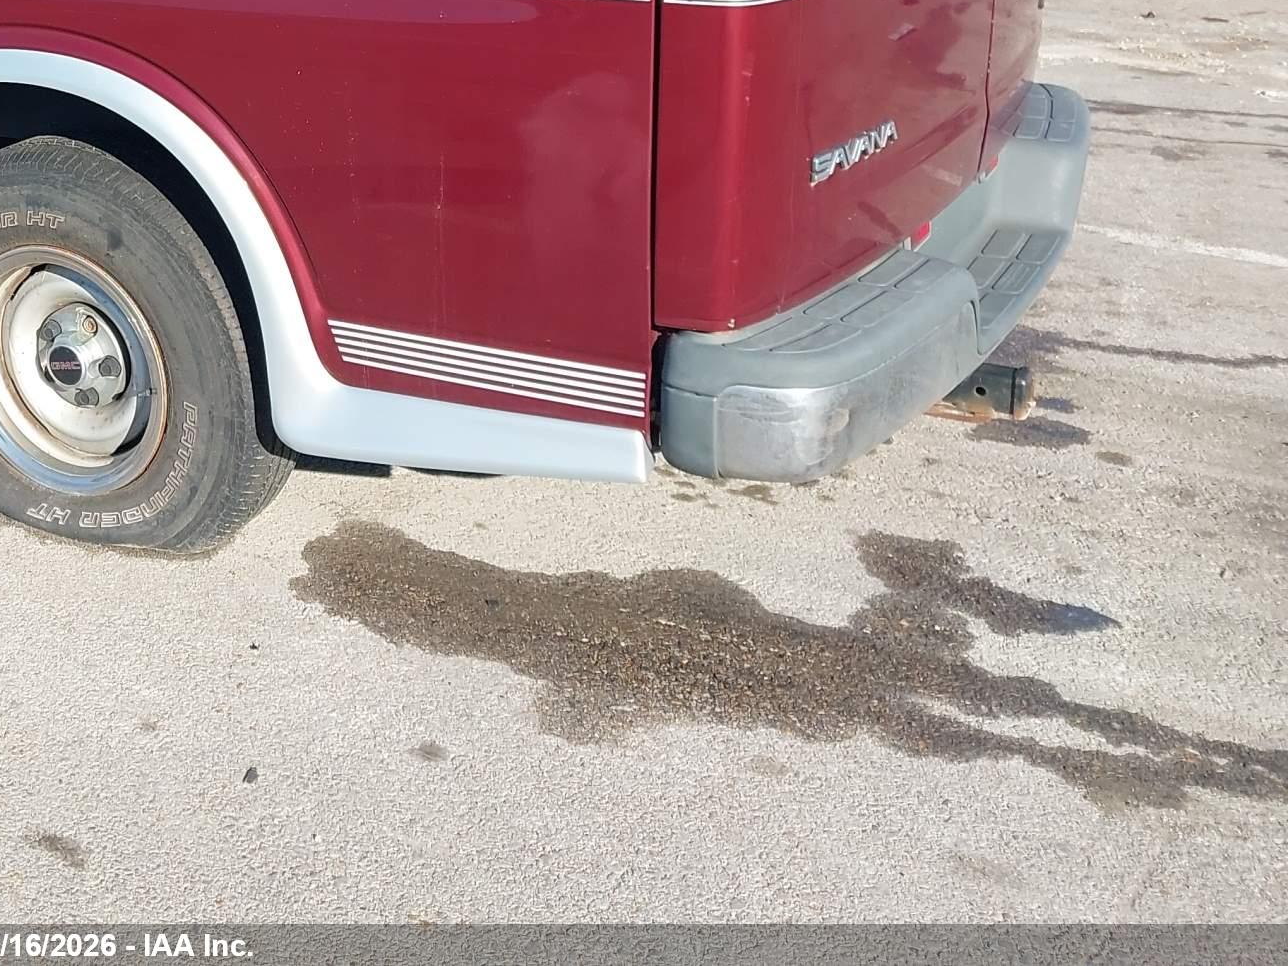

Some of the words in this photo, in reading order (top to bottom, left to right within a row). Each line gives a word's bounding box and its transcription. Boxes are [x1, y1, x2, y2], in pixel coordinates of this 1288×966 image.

[810, 120, 898, 187] SAVANA
[26, 210, 65, 230] HT
[51, 361, 81, 370] GMC
[78, 401, 198, 528] PATHFINDER
[26, 502, 71, 525] HT
